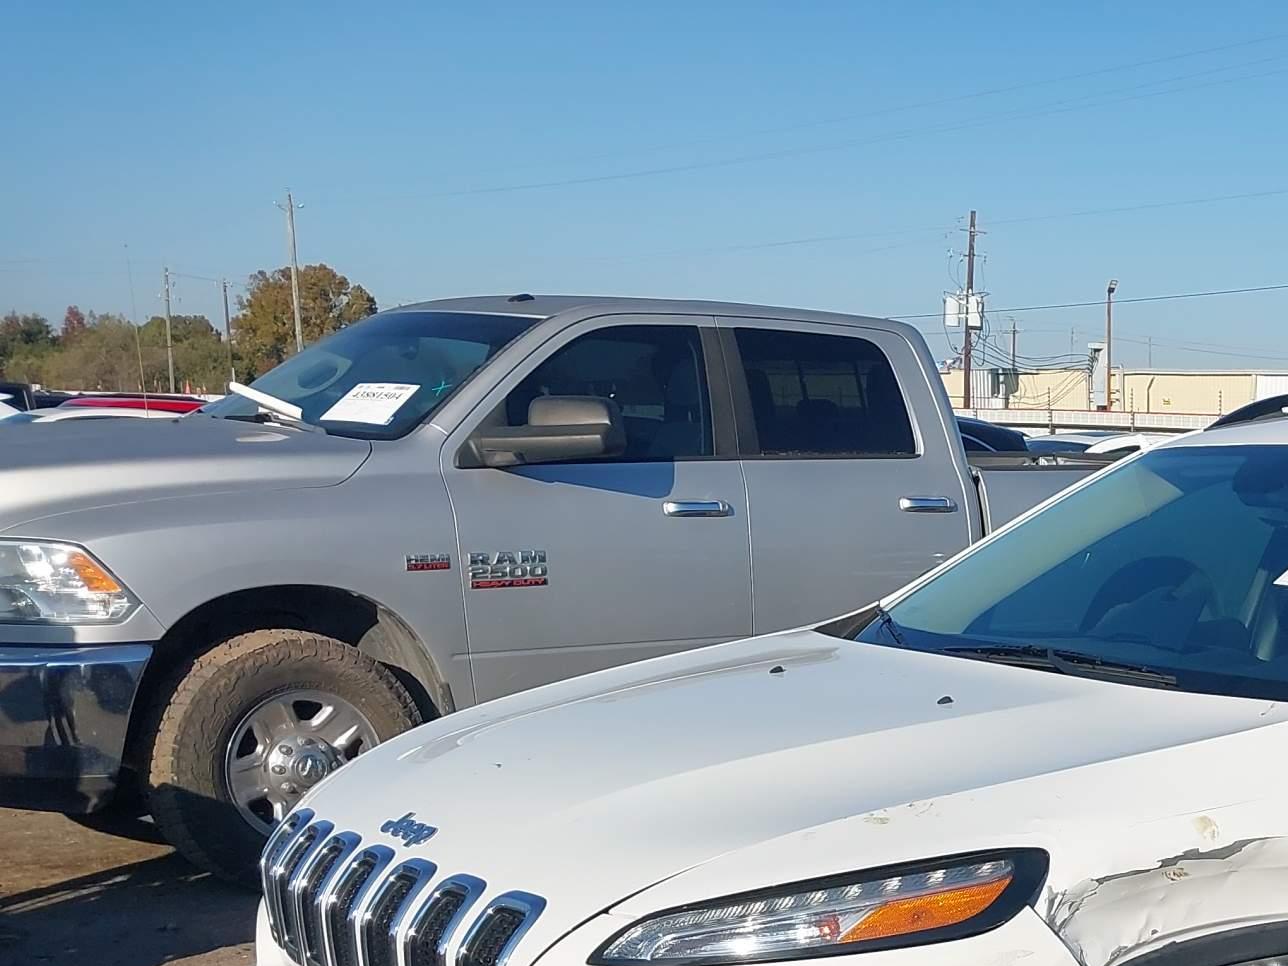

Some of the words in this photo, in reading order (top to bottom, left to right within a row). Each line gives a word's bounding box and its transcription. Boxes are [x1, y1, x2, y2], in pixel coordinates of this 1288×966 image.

[467, 550, 547, 566] RAM
[469, 565, 548, 580] 2500
[472, 579, 512, 588] HEAVY
[512, 577, 546, 586] DUTY
[380, 811, 439, 848] Jeep
